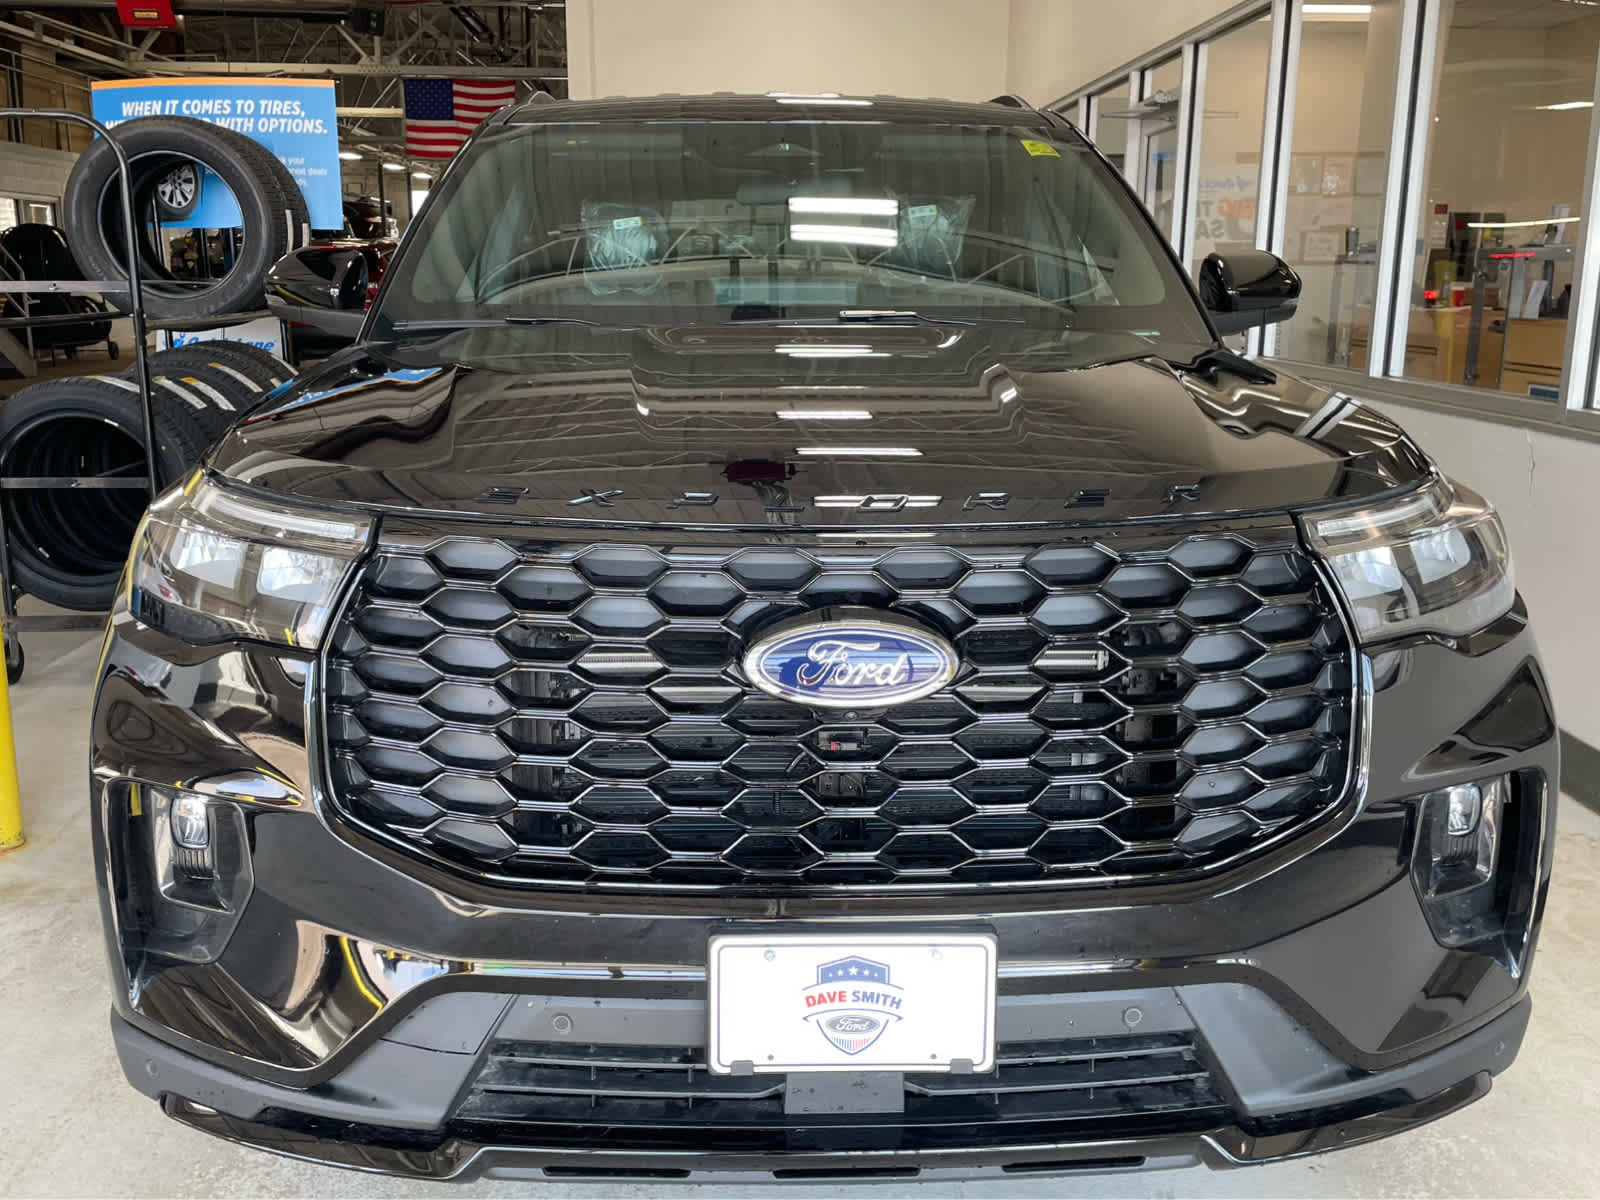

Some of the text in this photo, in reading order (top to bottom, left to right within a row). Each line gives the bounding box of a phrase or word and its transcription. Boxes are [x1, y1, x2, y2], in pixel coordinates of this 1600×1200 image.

[122, 99, 305, 118] WHEN IT COMES TO TIRES,
[257, 117, 328, 134] OPTIONS.
[797, 640, 909, 686] Ford
[805, 990, 902, 1010] DAVE SMITH
[836, 1015, 869, 1032] Ford
